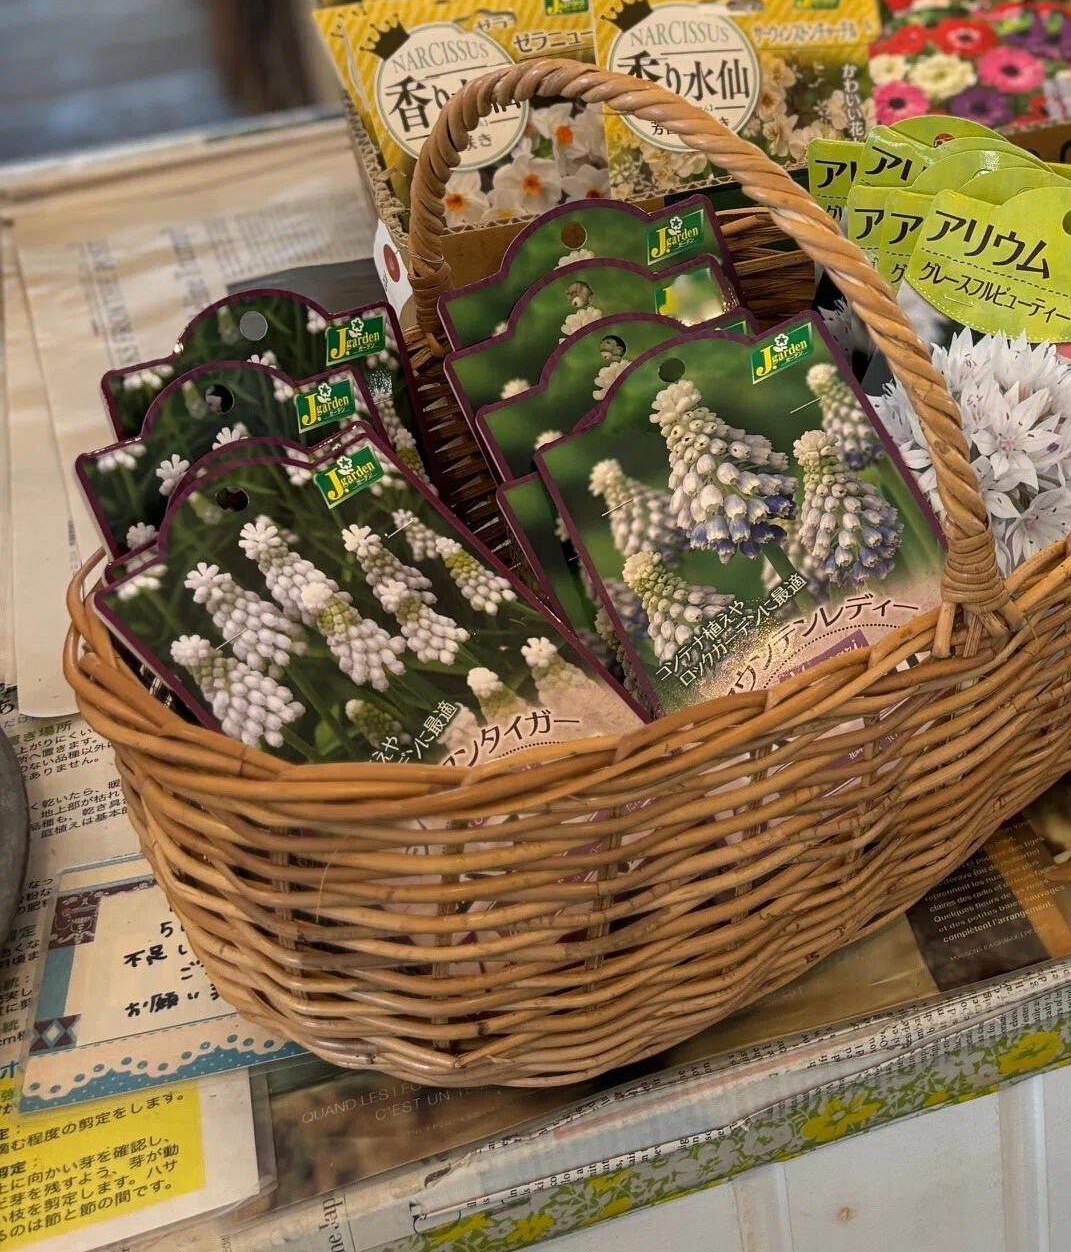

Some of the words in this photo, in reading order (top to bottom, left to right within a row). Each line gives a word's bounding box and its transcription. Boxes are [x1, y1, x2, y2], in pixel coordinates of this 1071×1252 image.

[630, 20, 730, 48] NARCISSUS
[392, 39, 490, 75] NARCISSUS
[650, 226, 700, 259] J.garden
[926, 209, 1051, 280] アリウム
[918, 261, 1071, 324] グレースフルビューティー
[329, 327, 382, 361] J.garden
[755, 339, 809, 378] J.garden
[301, 393, 350, 427] J.garden
[326, 459, 376, 501] J.garden
[655, 598, 746, 682] コンテナ植えや
[679, 572, 808, 688] ロックガーデンに最適
[725, 592, 920, 697] ウンテンレディー
[933, 905, 974, 923] Quelques
